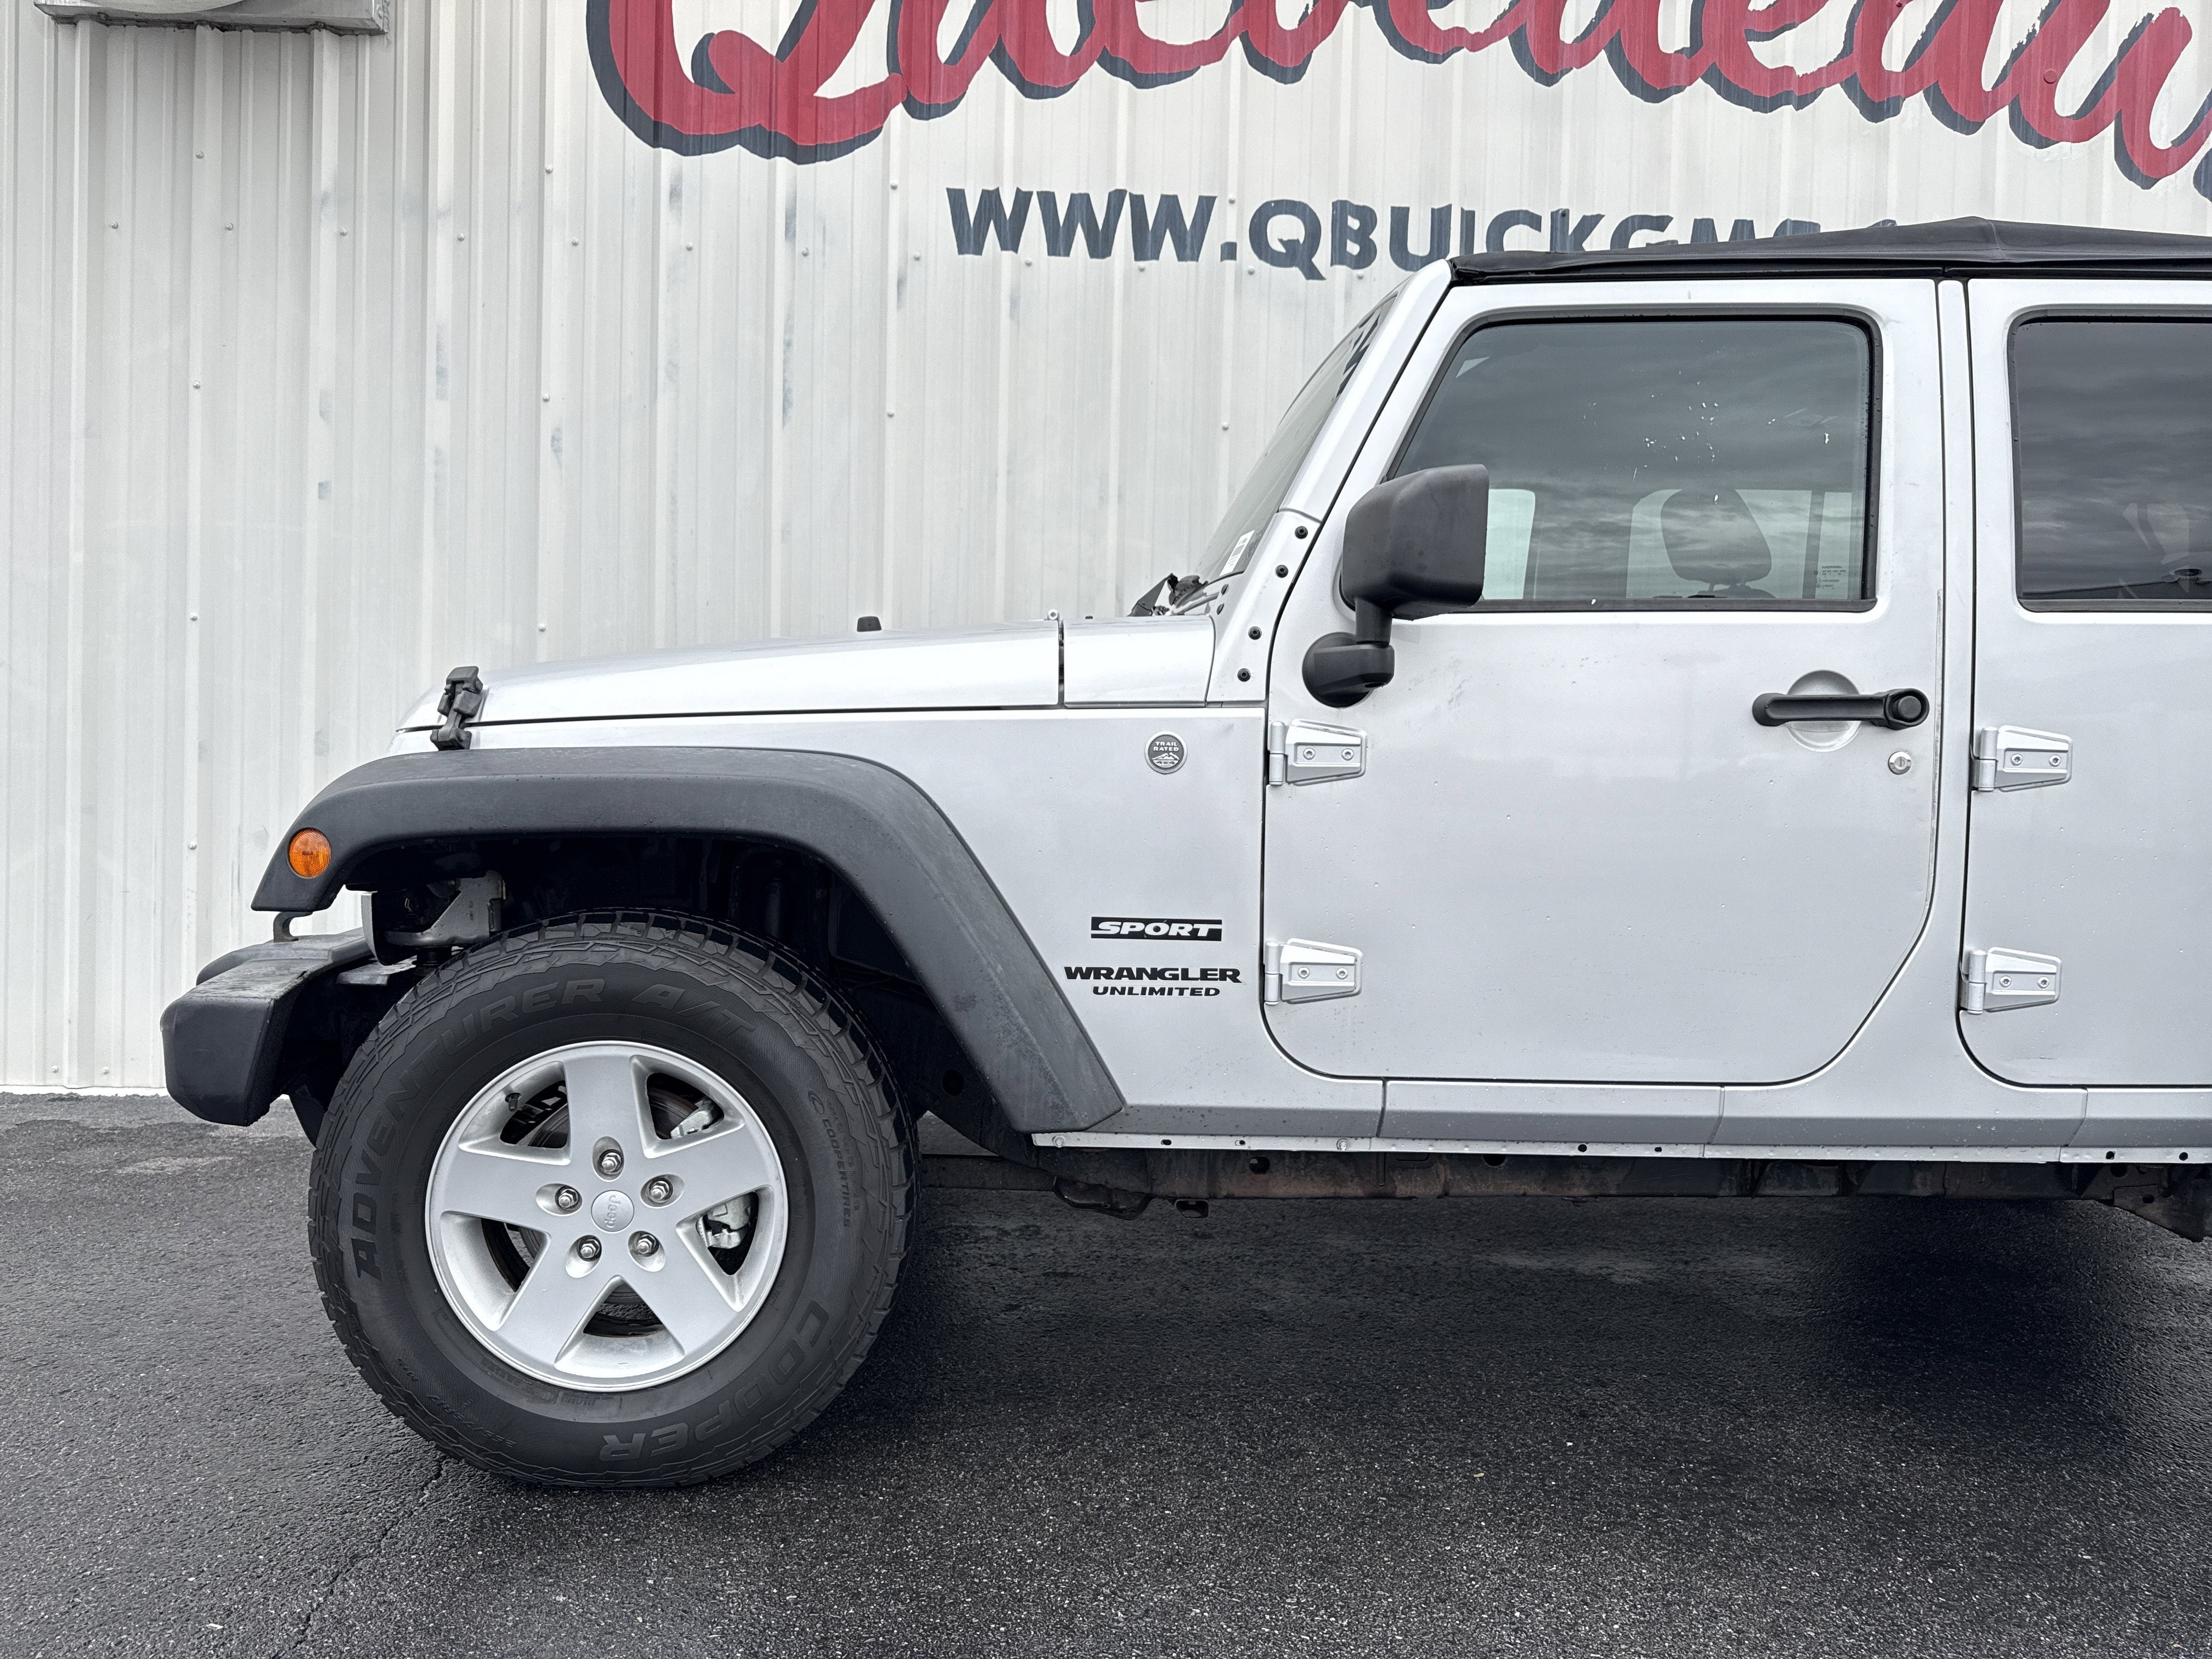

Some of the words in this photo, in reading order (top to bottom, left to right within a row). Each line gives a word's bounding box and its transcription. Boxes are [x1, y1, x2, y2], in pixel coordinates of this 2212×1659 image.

[1091, 919, 1222, 938] SPORT
[1063, 966, 1243, 984] WRANGLER
[1092, 986, 1221, 996] UNLIMITED
[351, 978, 606, 1281] ADVENTURER
[631, 983, 757, 1037] A/T
[604, 1195, 621, 1228] Jeep
[599, 1300, 830, 1462] COOPER
